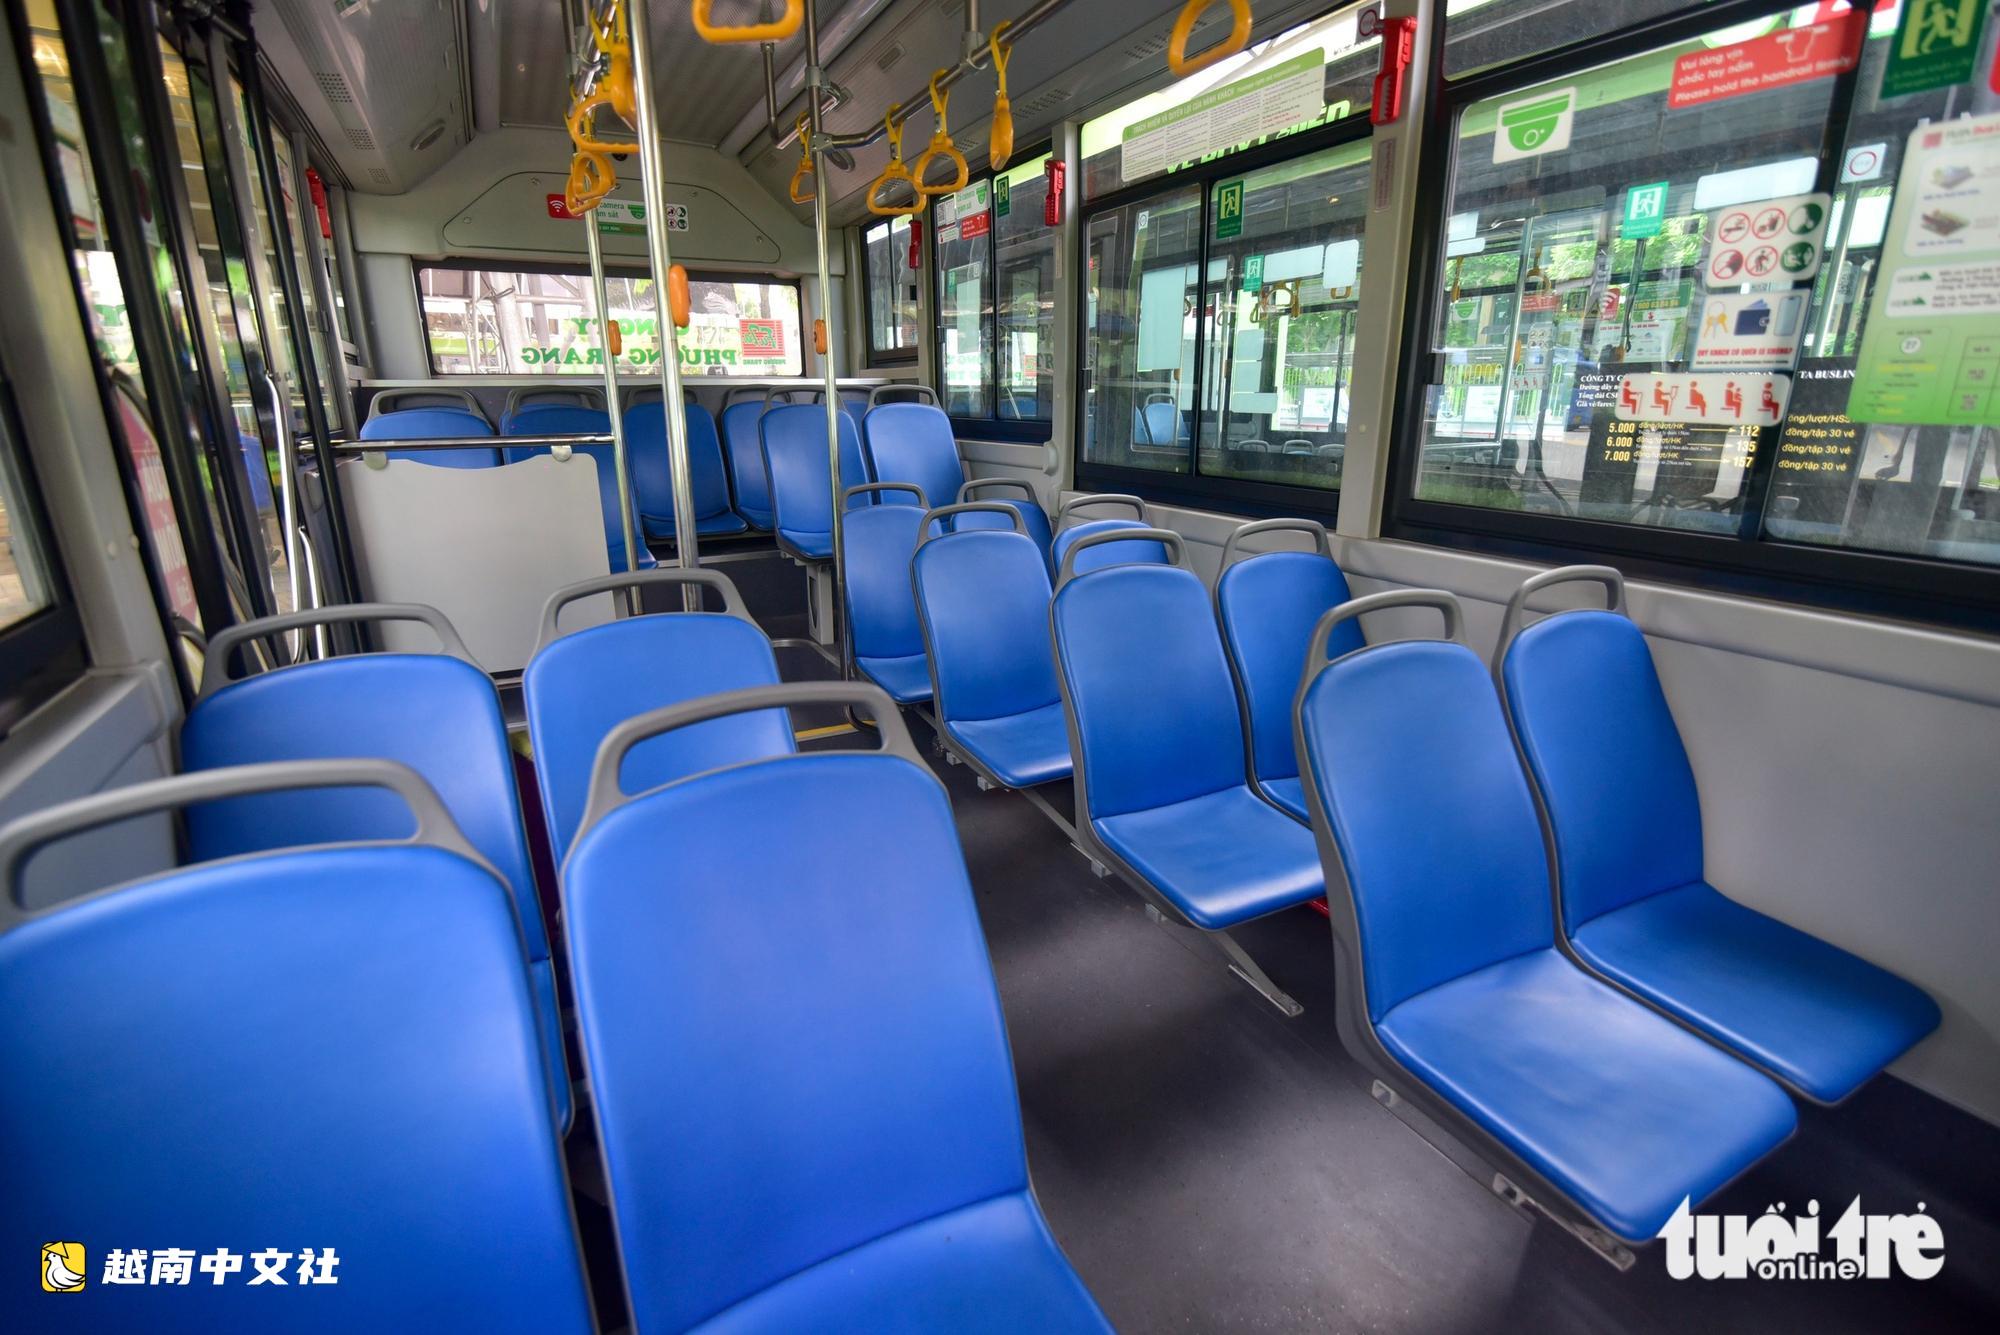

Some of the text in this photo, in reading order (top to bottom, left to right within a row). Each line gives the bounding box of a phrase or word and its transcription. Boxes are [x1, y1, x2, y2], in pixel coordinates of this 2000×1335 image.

[1675, 88, 1710, 102] Please
[1712, 81, 1738, 94] hold
[1740, 76, 1759, 87] the
[1761, 64, 1814, 83] handrail
[1580, 374, 1604, 382] CÔNG
[1605, 374, 1617, 382] TY
[1815, 370, 1856, 379] BUSLIN
[1609, 422, 1635, 434] 5.000
[1829, 428, 1842, 437] 30
[1606, 436, 1633, 447] 6.000
[1825, 445, 1838, 454] 30
[1604, 451, 1630, 462] 7.000
[1821, 461, 1834, 471] 30
